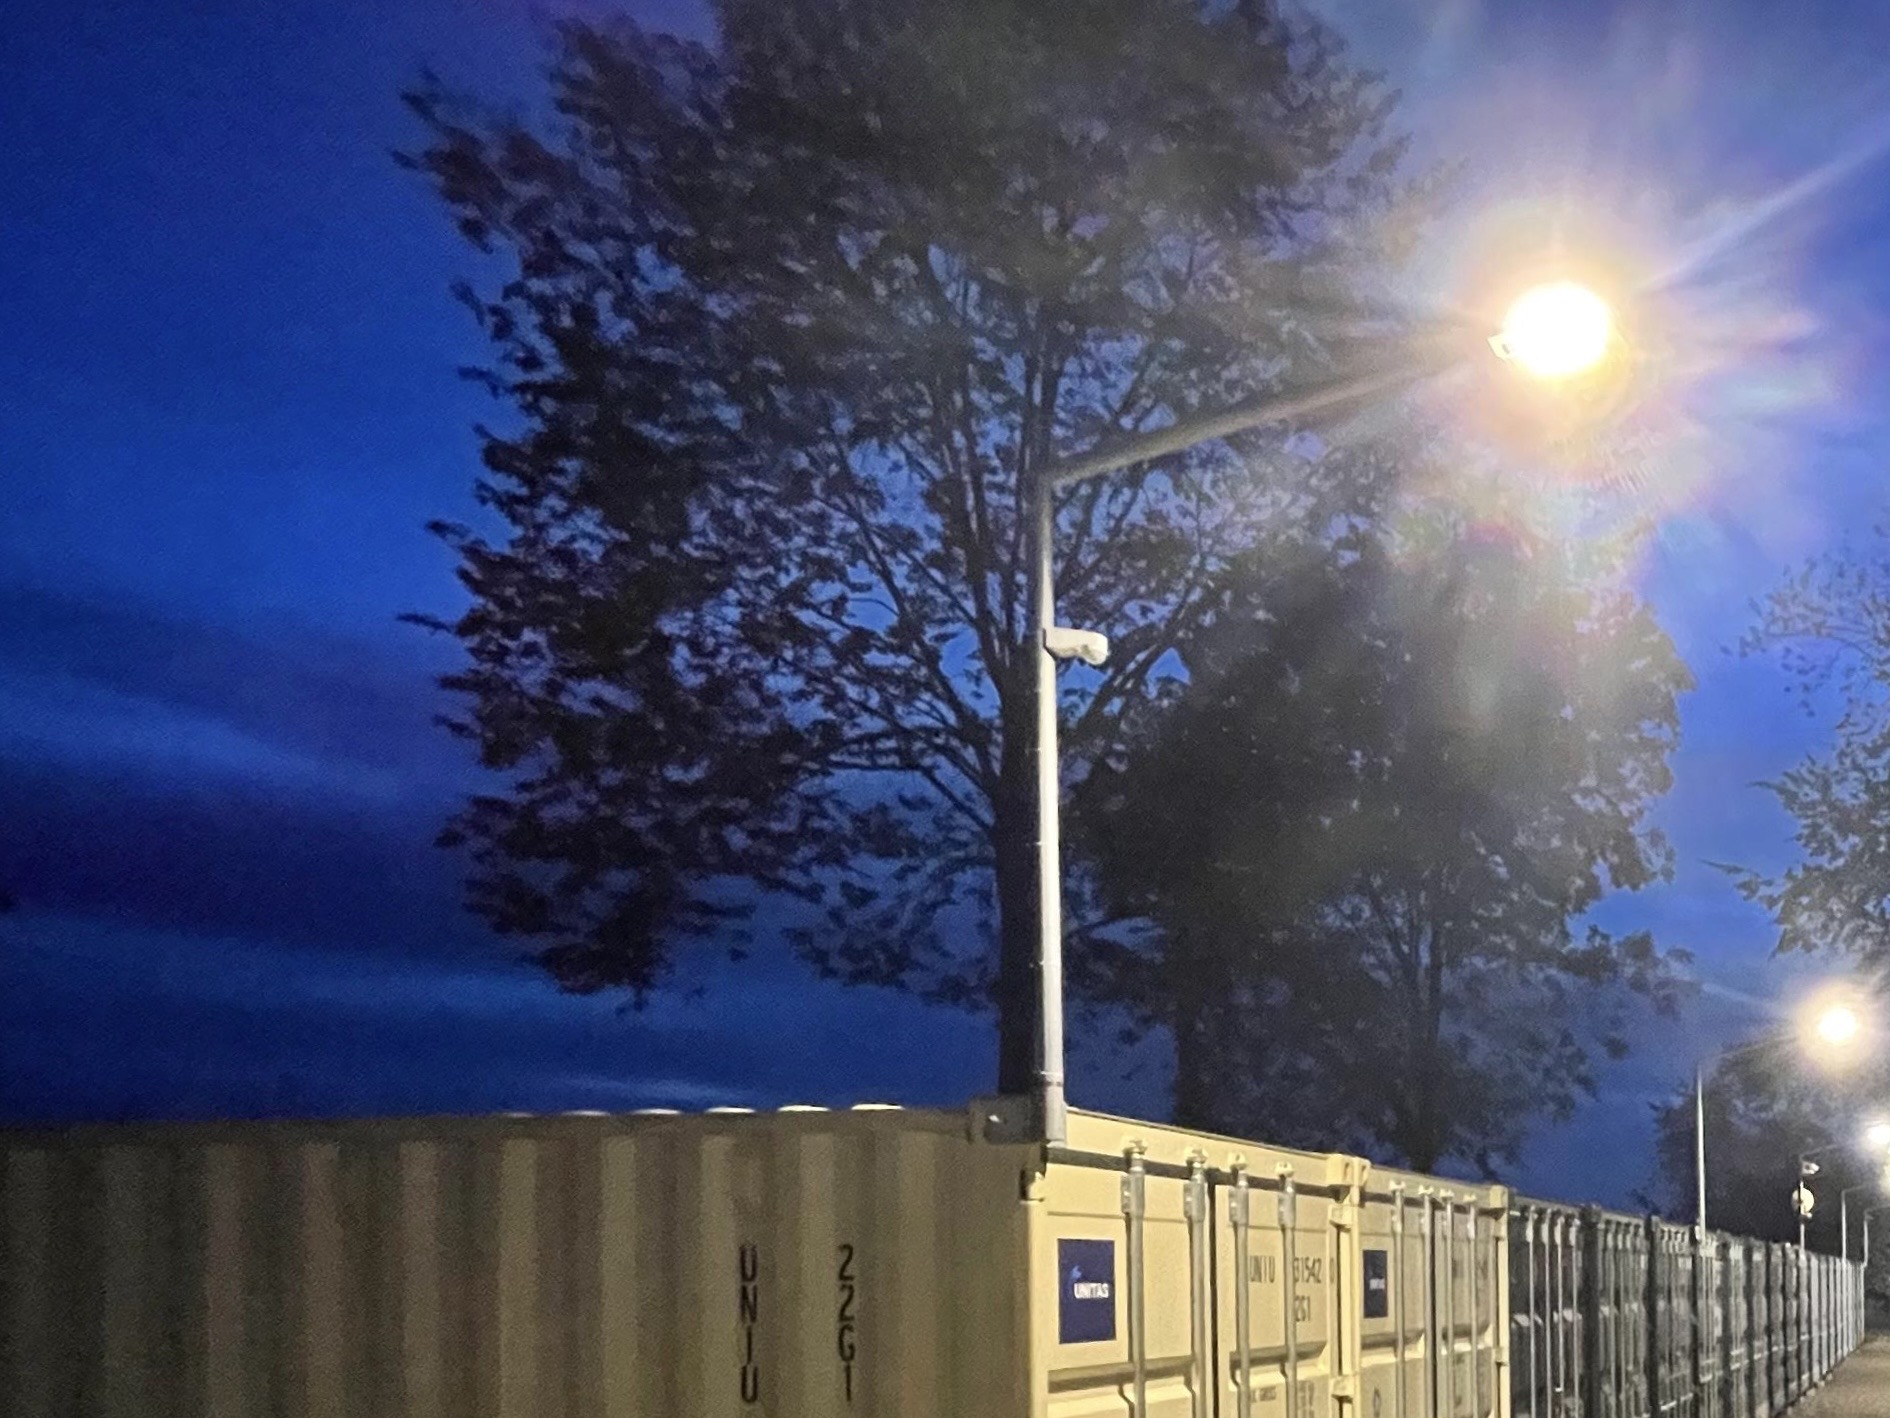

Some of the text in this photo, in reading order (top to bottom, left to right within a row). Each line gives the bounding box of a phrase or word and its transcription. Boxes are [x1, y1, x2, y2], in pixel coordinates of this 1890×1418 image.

[740, 1244, 758, 1402] UNIU
[838, 1243, 856, 1403] 22G1
[1292, 1256, 1322, 1284] 31542
